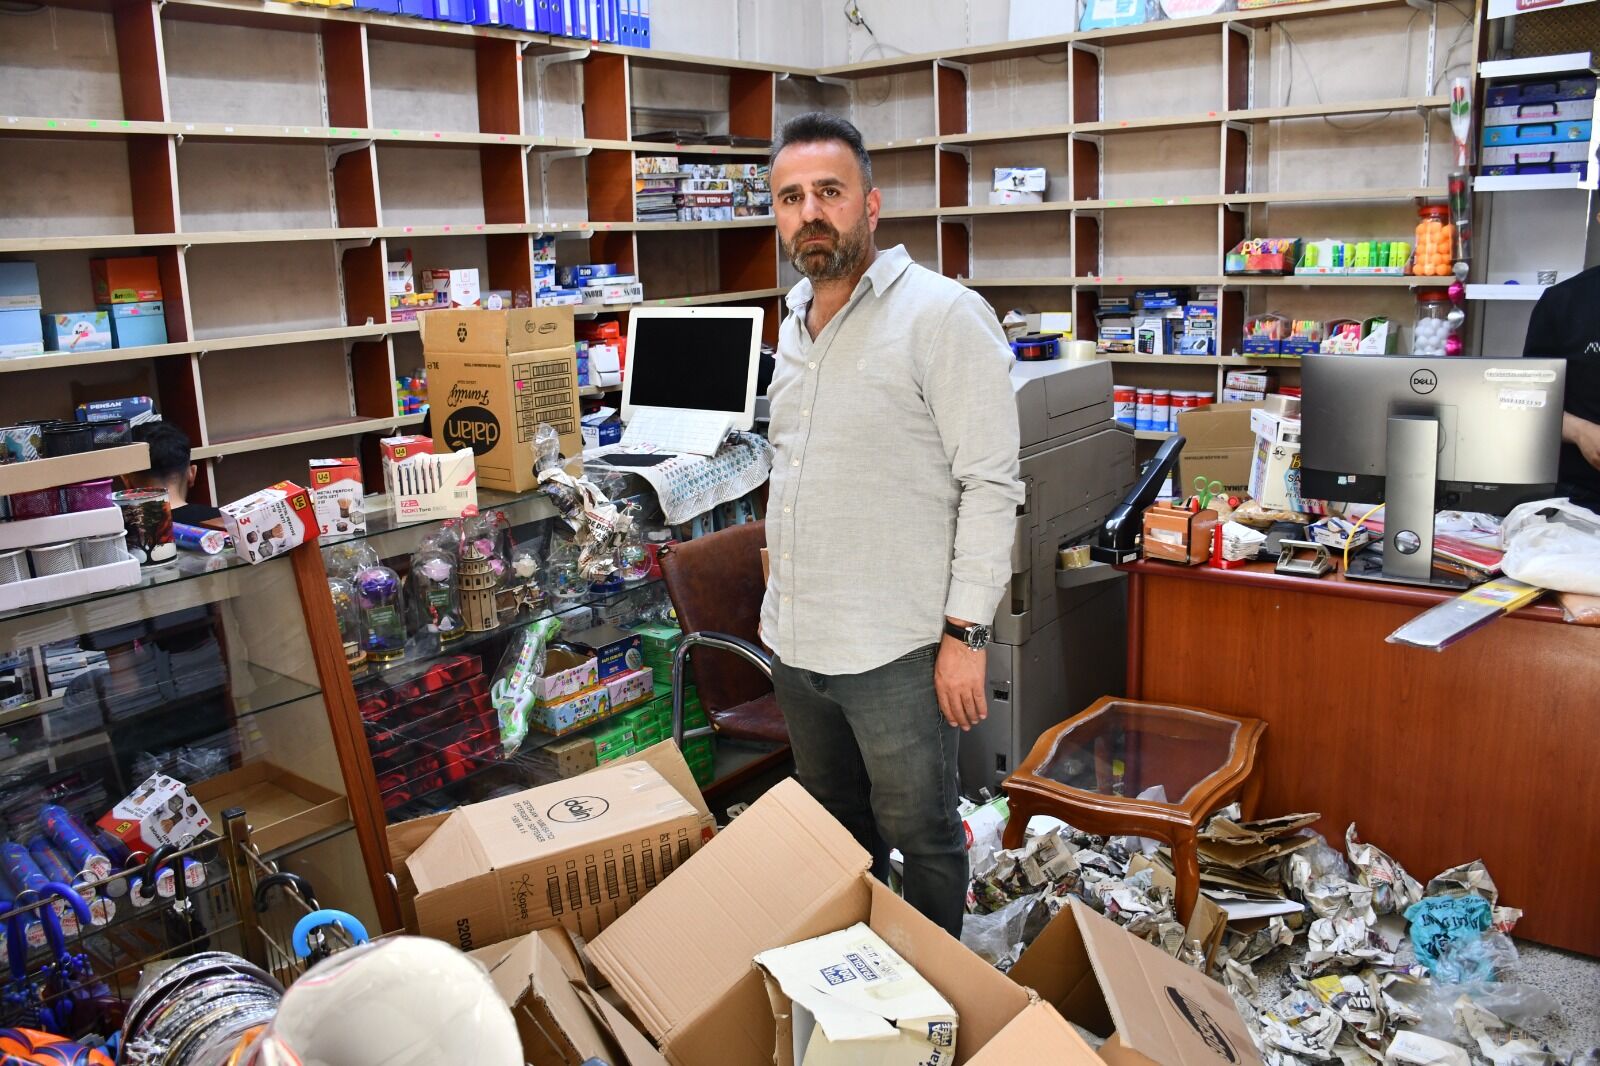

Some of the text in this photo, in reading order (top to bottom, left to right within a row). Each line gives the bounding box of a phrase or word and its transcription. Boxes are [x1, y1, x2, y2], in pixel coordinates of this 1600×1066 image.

[90, 401, 121, 410] PENSAN
[447, 384, 489, 407] Family
[448, 420, 498, 445] dalan
[240, 516, 251, 525] 3
[517, 892, 528, 919] Kopas
[847, 953, 878, 980] FRAGILE
[941, 1022, 951, 1046] FREE
